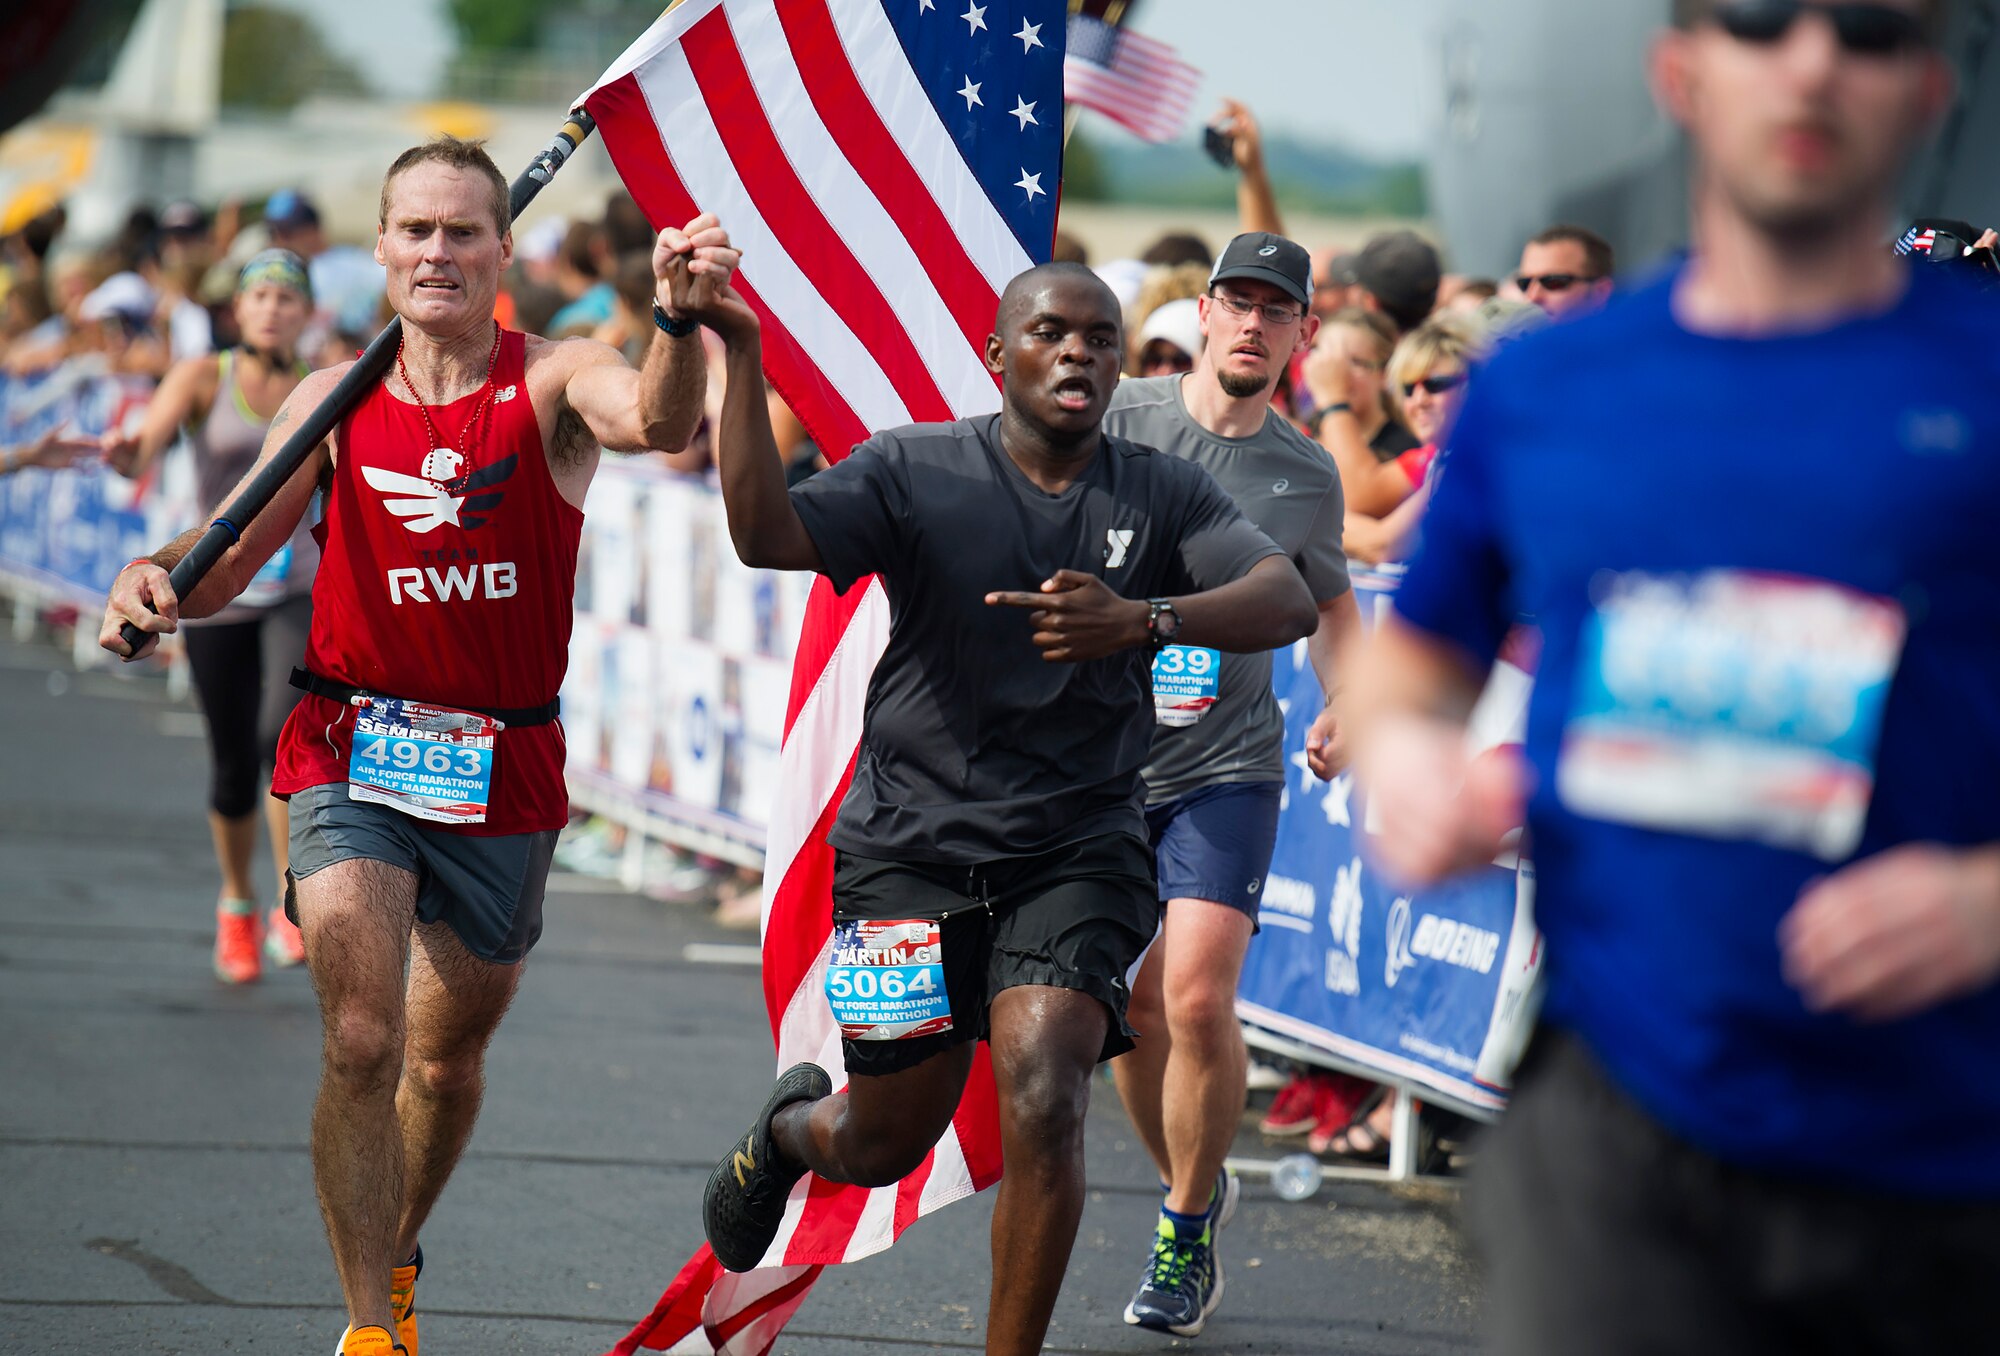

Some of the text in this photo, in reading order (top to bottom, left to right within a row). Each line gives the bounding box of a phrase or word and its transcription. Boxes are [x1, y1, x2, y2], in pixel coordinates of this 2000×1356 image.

[421, 548, 479, 562] TEAM
[387, 562, 518, 605] RWB
[1151, 648, 1212, 675] 39
[1153, 684, 1202, 696] ARATHON
[1158, 674, 1214, 686] MARATHON
[357, 718, 455, 743] SEMPER
[361, 739, 482, 776] 4963
[356, 765, 484, 790] AIR FORCE MARATHON
[368, 776, 399, 789] HALF
[401, 784, 469, 800] MARATHON
[914, 946, 931, 964] G
[1409, 913, 1500, 974] BOEING
[830, 968, 937, 998] 5064
[832, 996, 943, 1011] AIR FORCE MARATHON
[841, 1008, 932, 1022] HALF MARATHON
